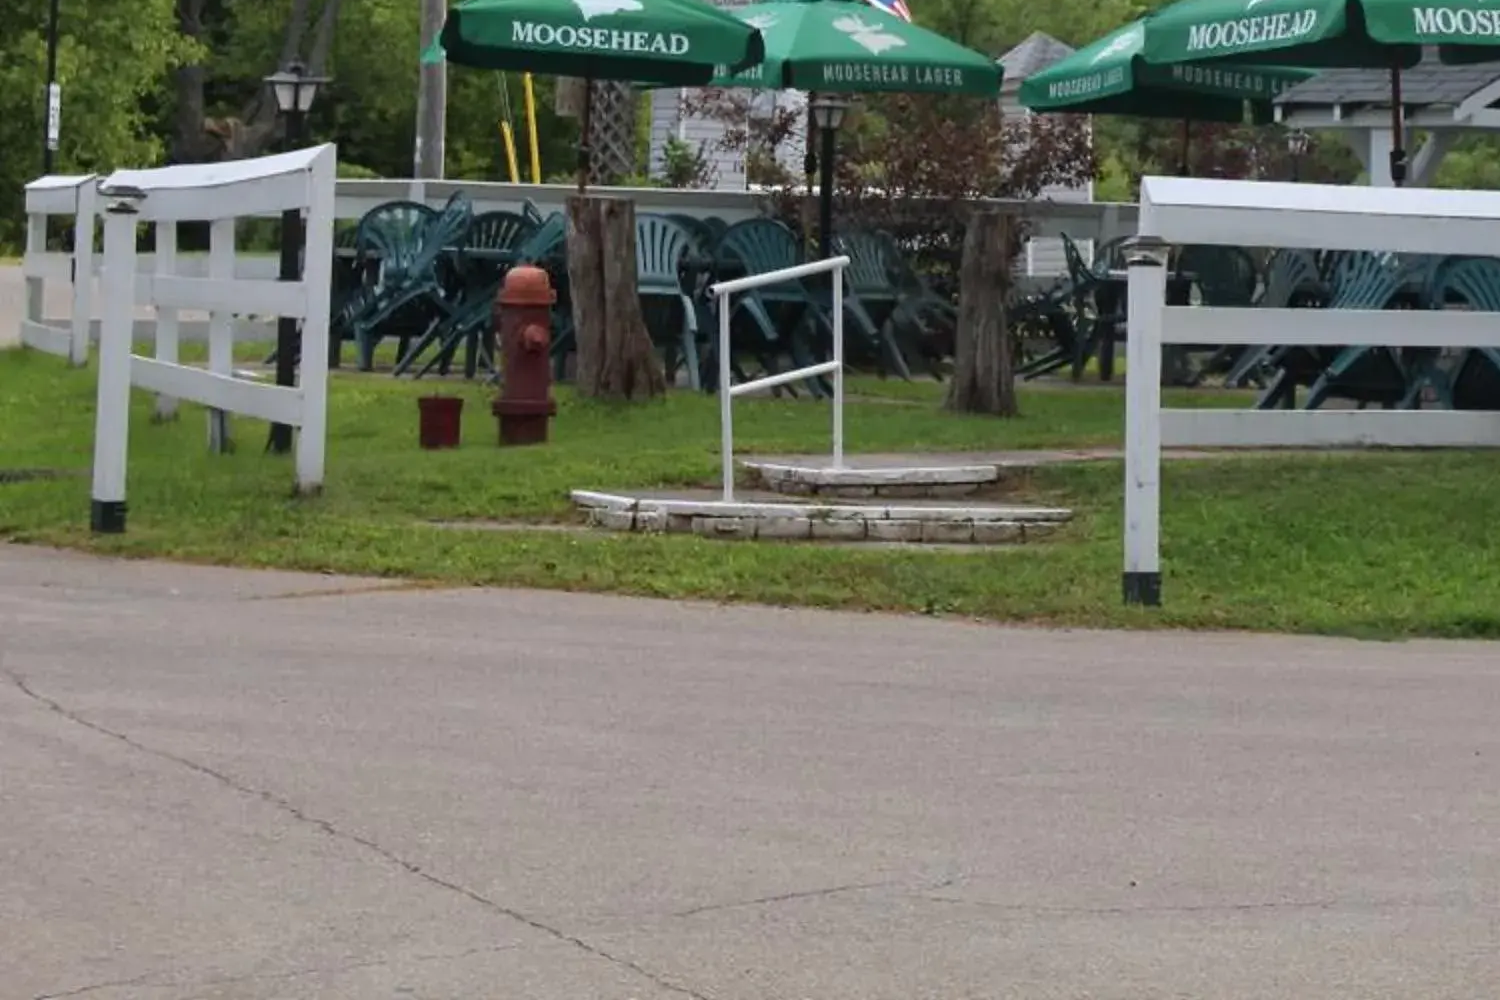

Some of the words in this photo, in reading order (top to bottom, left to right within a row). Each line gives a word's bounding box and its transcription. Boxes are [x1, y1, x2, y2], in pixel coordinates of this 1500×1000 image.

[511, 21, 690, 55] MOOSEHEAD
[1186, 9, 1318, 51] MOOSEHEAD
[823, 63, 909, 84] MOOSEHEAD
[915, 66, 964, 86] LAGER
[1172, 64, 1264, 92] MOOSEHEAD
